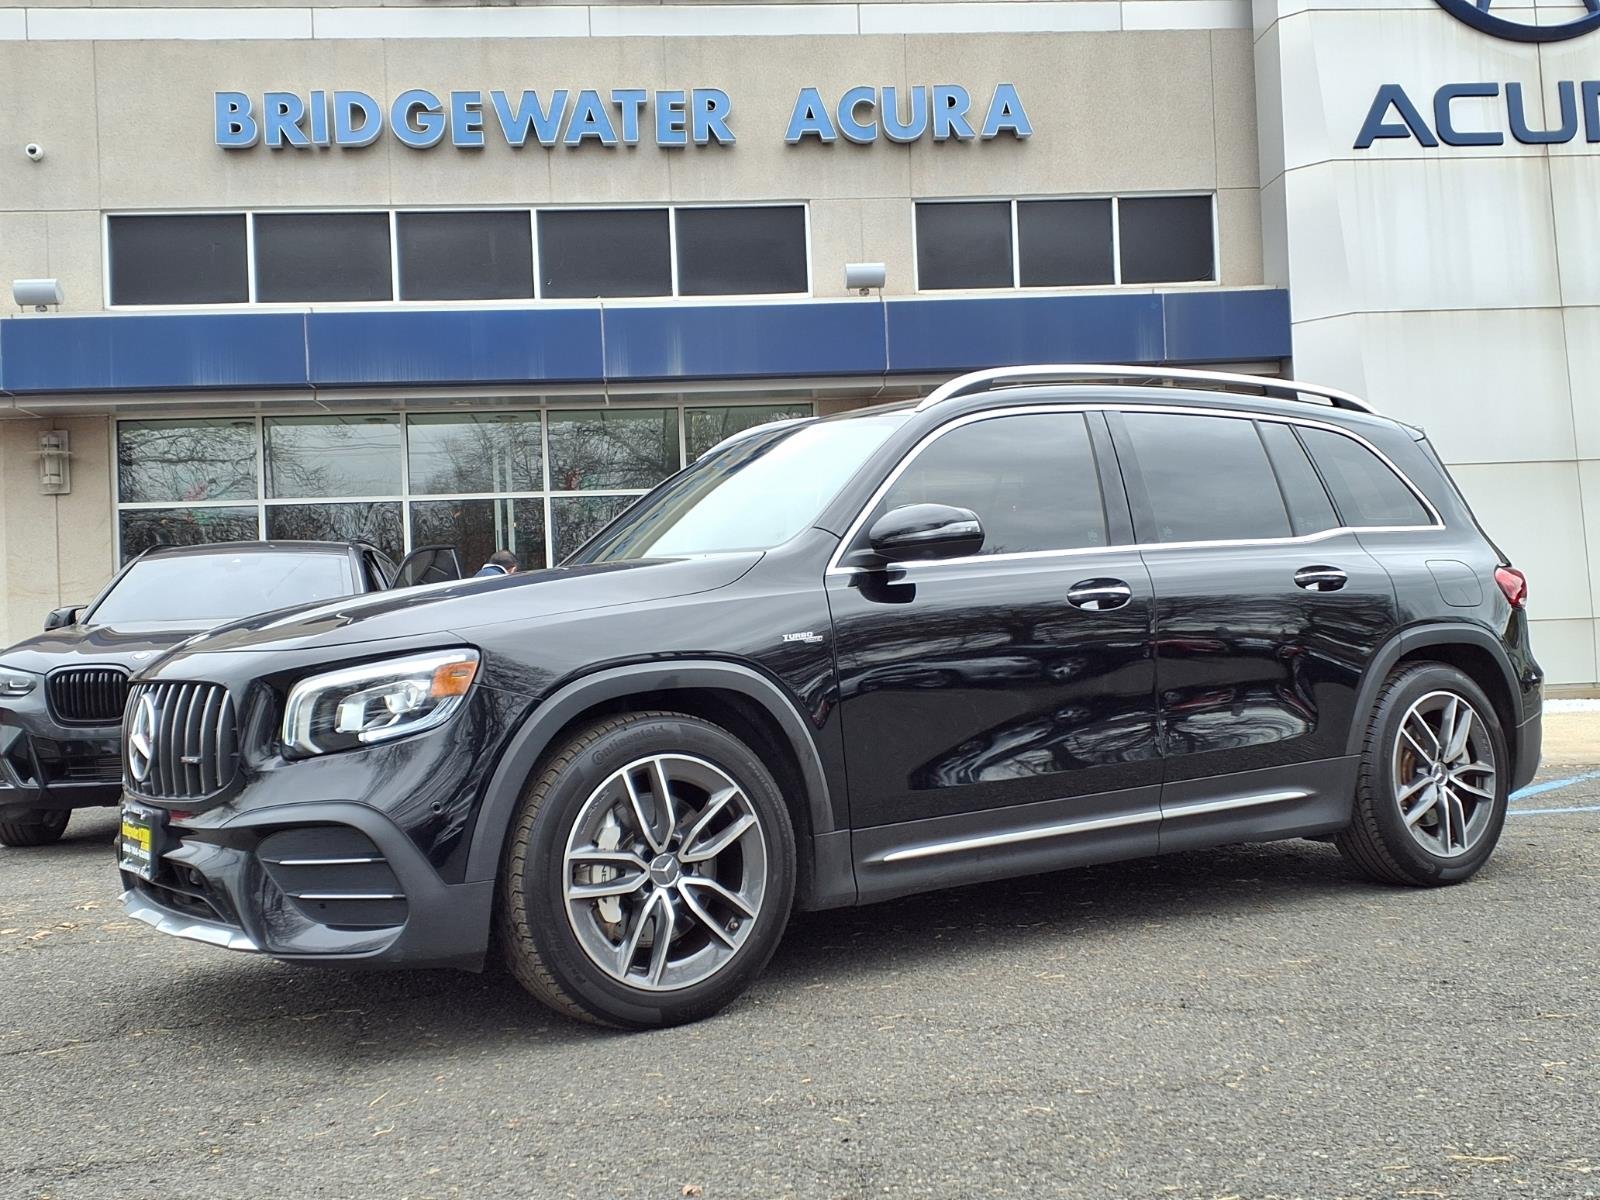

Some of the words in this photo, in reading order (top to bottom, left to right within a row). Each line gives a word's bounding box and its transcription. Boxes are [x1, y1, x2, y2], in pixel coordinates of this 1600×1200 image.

[214, 88, 736, 149] BRIDGEWATER
[784, 83, 1034, 144] ACURA
[782, 631, 813, 642] TURBO
